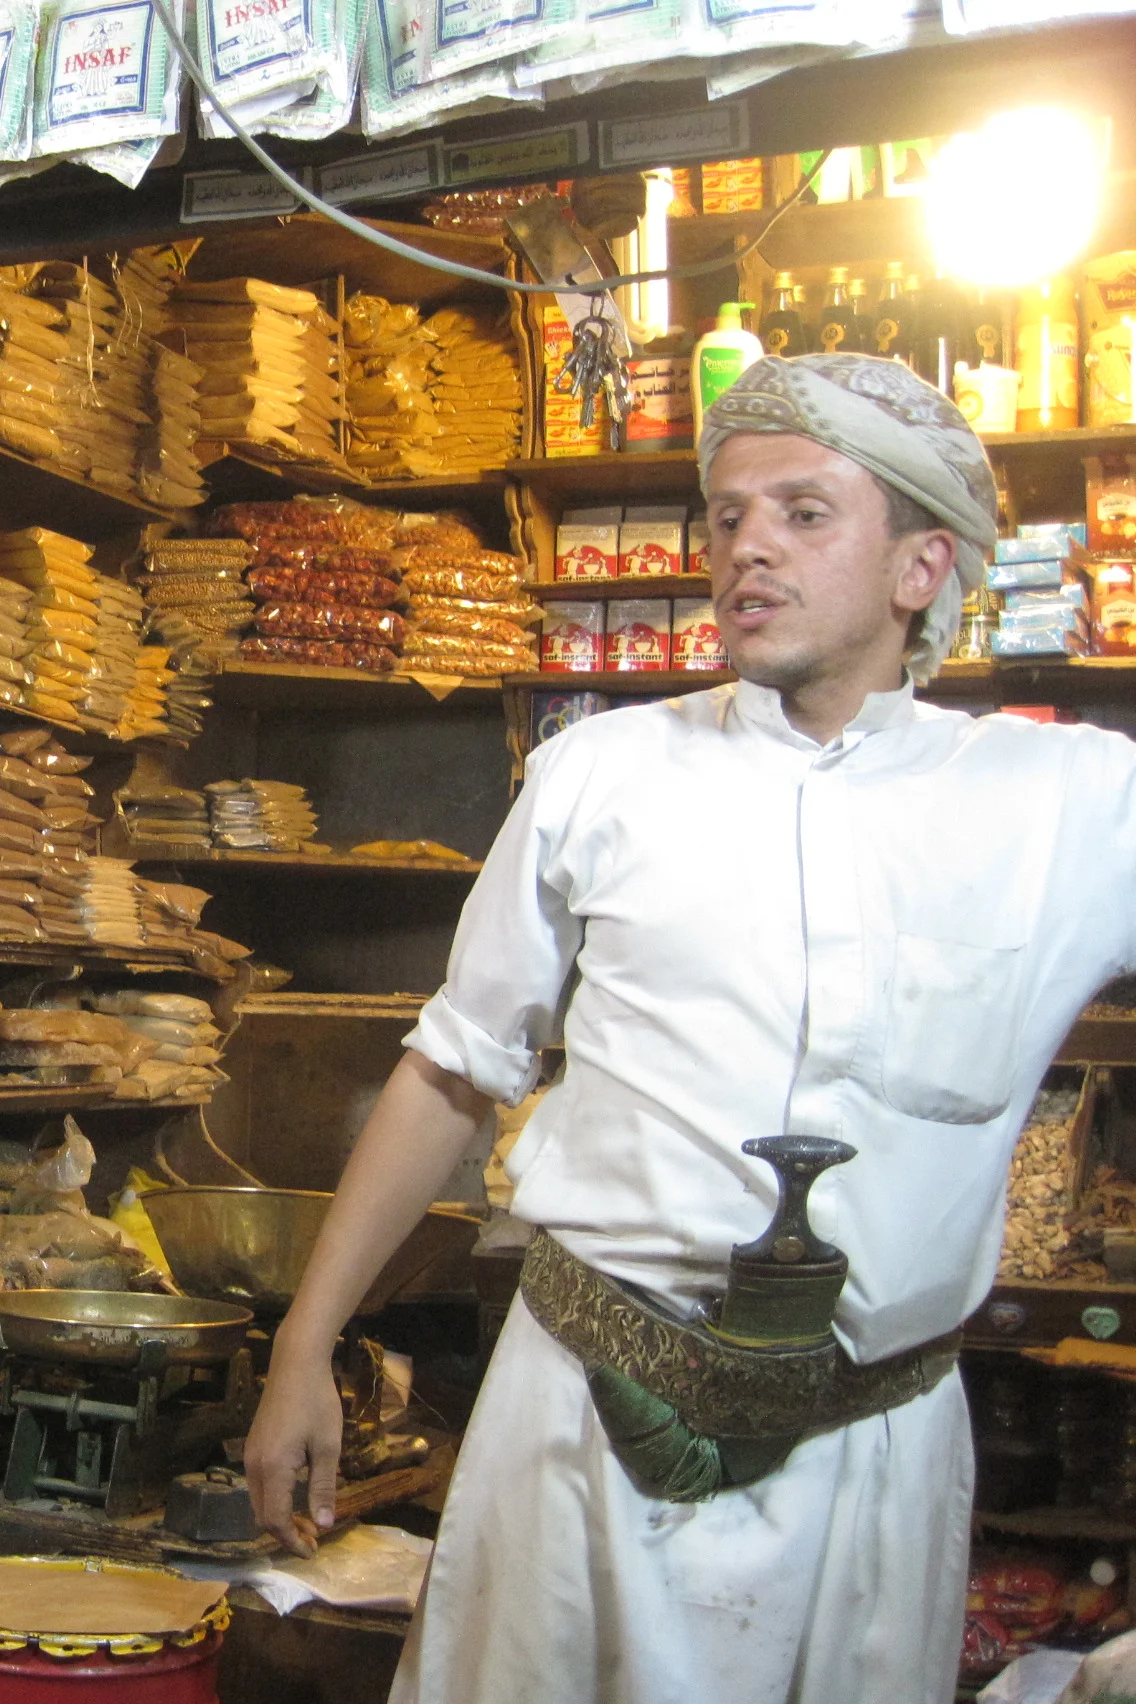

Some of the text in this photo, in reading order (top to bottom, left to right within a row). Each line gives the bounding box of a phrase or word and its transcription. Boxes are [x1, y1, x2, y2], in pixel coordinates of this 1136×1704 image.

[63, 45, 133, 75] INSAF
[544, 653, 597, 661] saf-instant
[607, 653, 663, 661] saf-instant
